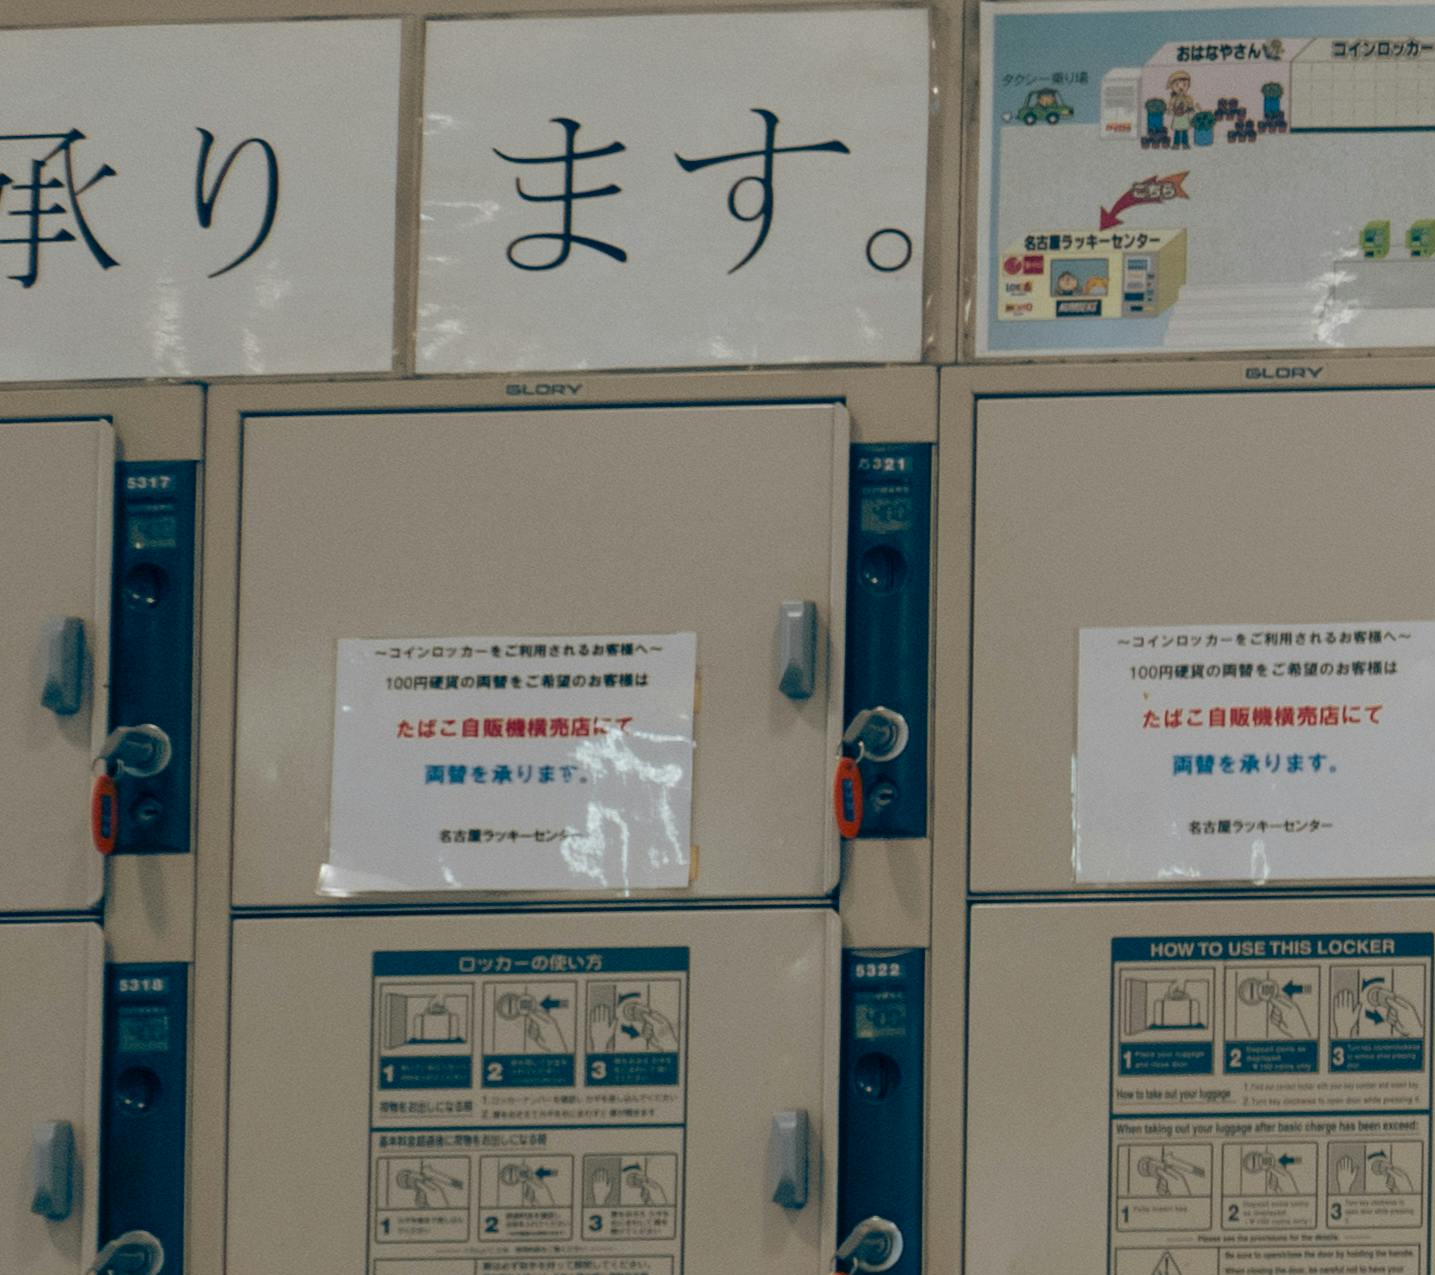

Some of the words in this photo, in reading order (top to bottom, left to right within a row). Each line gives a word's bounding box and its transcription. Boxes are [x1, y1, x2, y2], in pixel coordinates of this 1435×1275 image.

[1176, 44, 1261, 63] おはなやさん
[1332, 38, 1434, 59] コインロッカー
[1132, 180, 1176, 199] こちら
[1024, 232, 1161, 252] 名古屋ラッキーセンター
[1245, 367, 1324, 380] GLORY
[506, 384, 583, 396] GLORY
[1142, 704, 1383, 729] たばこ自販機横売店にて
[1171, 751, 1337, 777] 両替を承ります。
[1151, 943, 1191, 958] HOW
[1199, 942, 1222, 957] TO
[1228, 941, 1265, 957] USE
[1271, 940, 1311, 956] THIS
[1317, 939, 1395, 955] LOCKER
[458, 955, 602, 972] ロッカーの使い方
[855, 964, 900, 977] 5322
